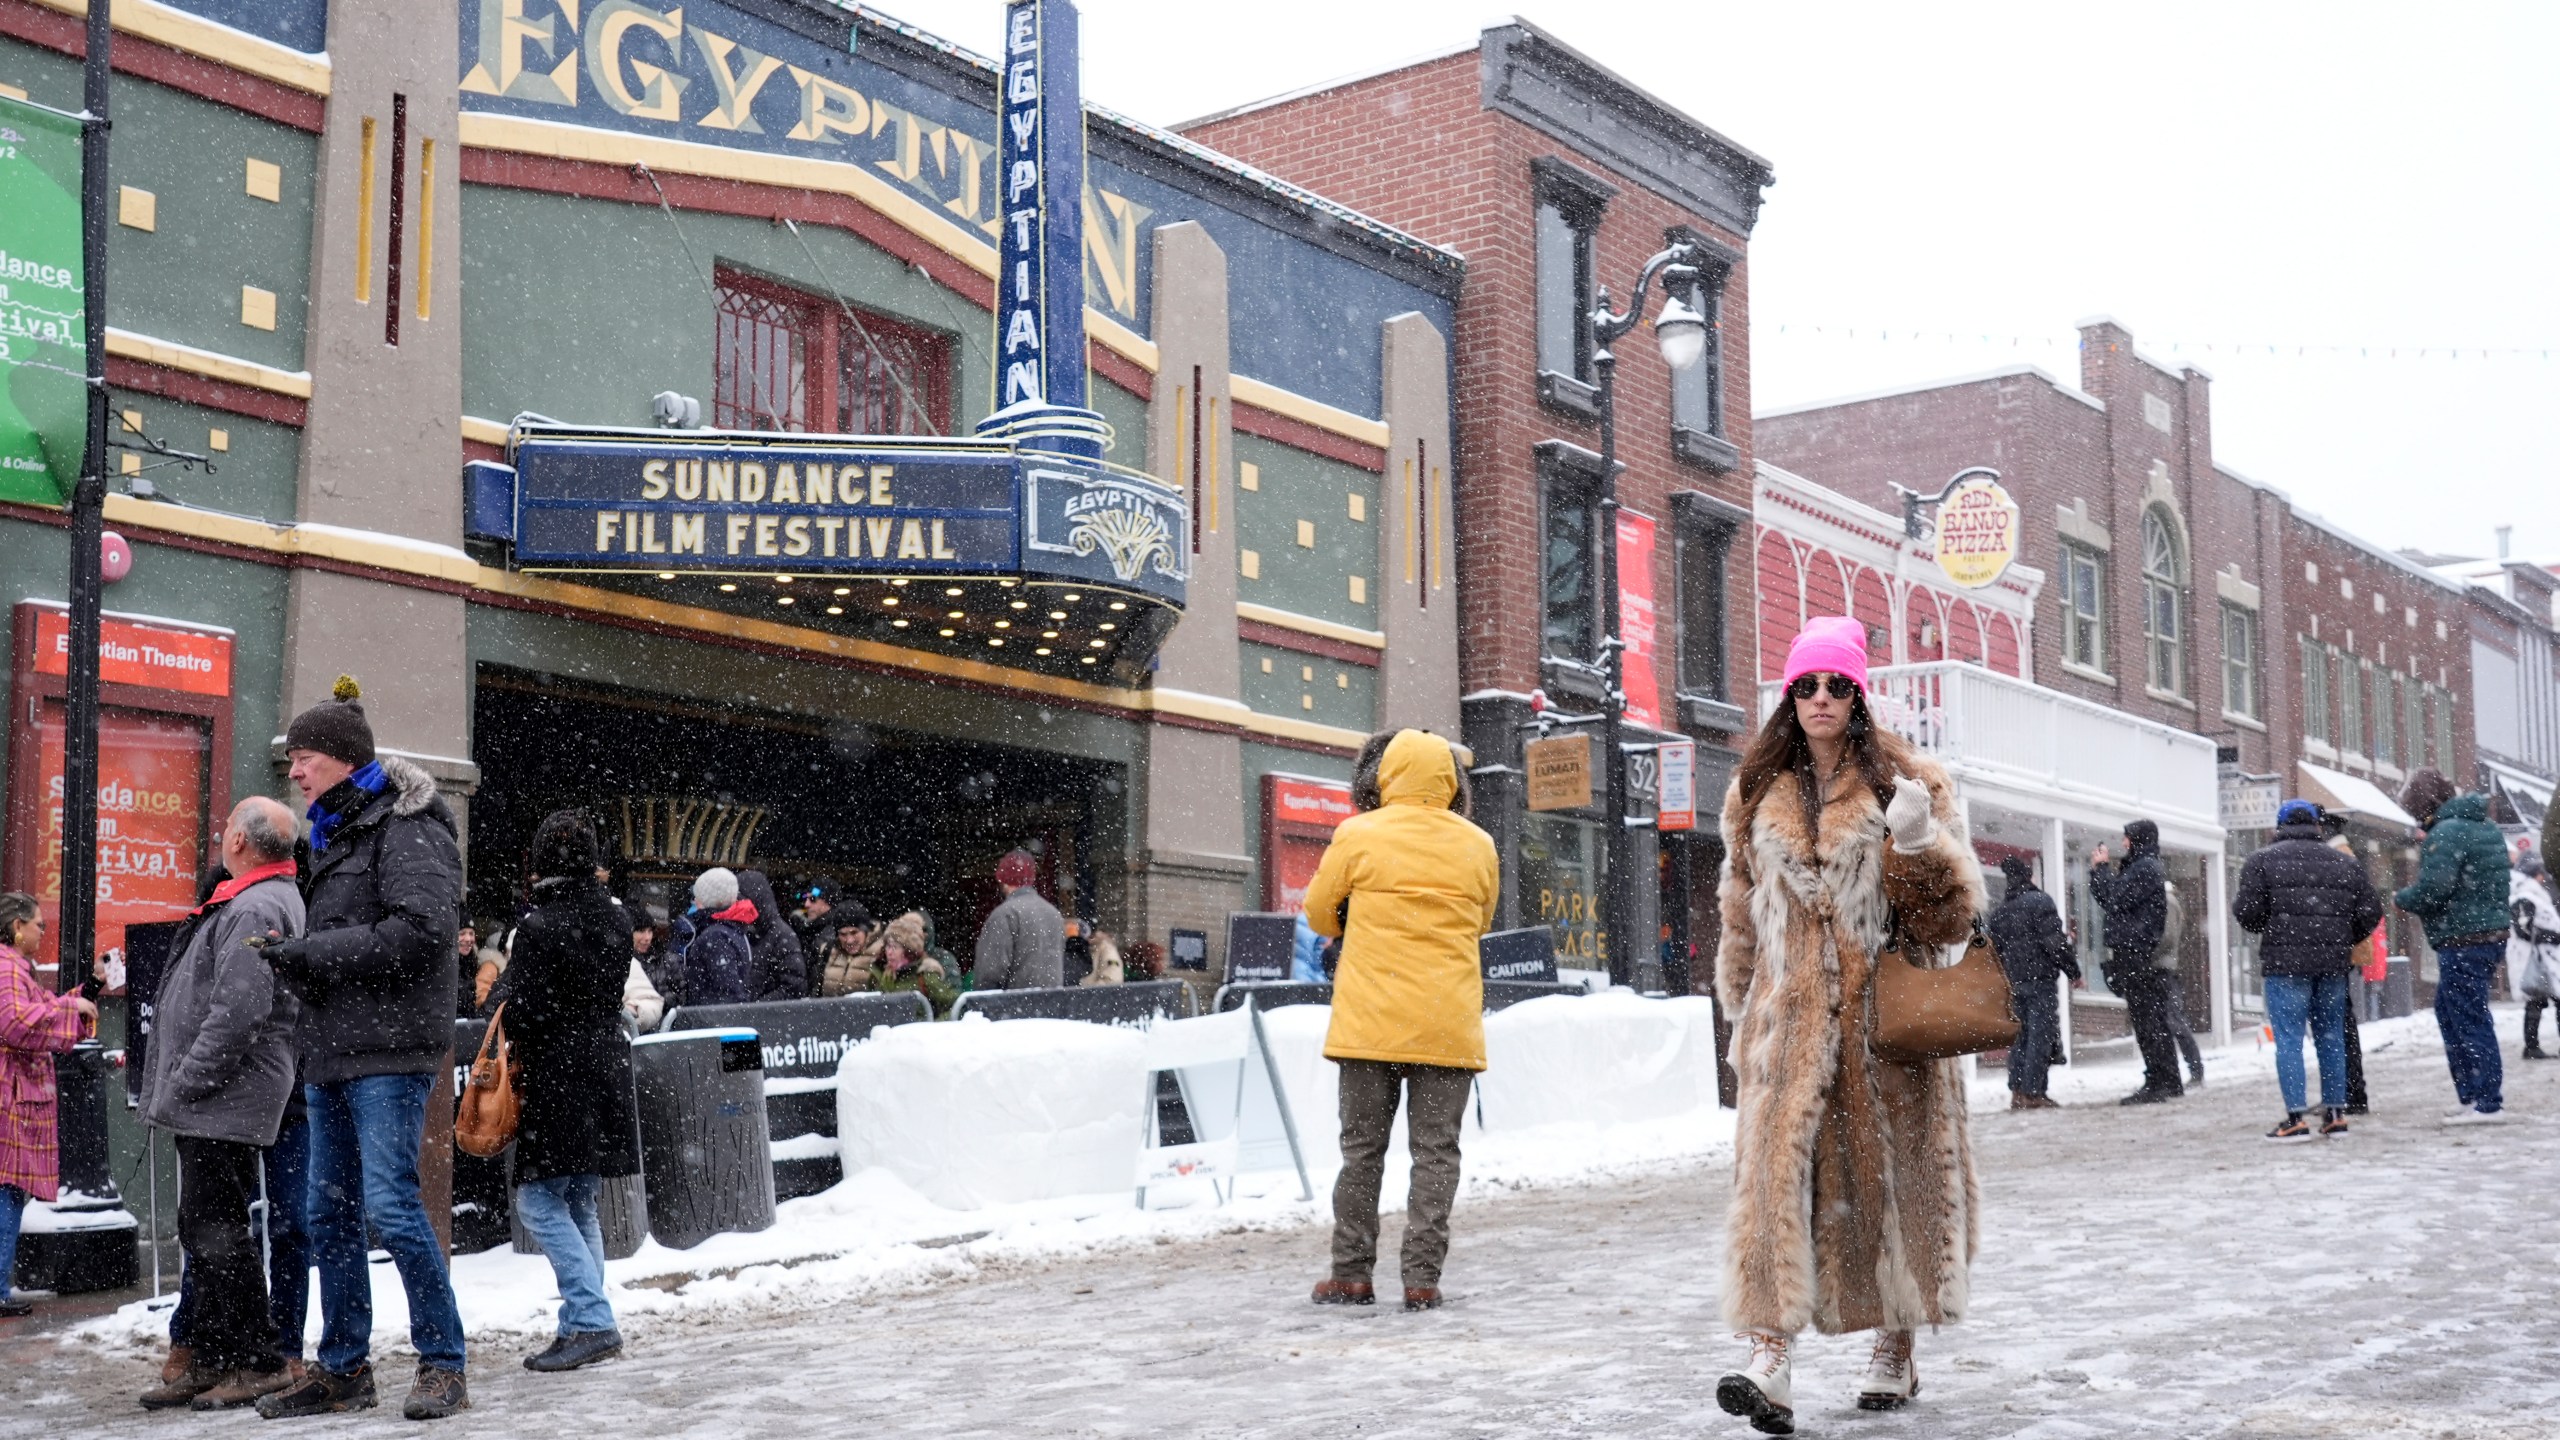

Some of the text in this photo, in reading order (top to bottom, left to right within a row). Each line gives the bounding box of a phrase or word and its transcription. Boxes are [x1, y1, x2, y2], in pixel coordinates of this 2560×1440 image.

[458, 0, 1152, 320] EGYPTIN
[1007, 8, 1041, 405] EGYPTIAN
[641, 458, 895, 506] SUNDANCE
[1064, 489, 1169, 536] EGYPTIAN
[1960, 490, 1993, 509] RED
[596, 511, 956, 561] FILM FESTIVAL
[1944, 511, 2009, 532] BANJO
[1942, 532, 2007, 554] PIZZA
[141, 645, 212, 673] Theatre
[50, 775, 181, 811] Sdance
[1541, 888, 1600, 922] PARK
[1489, 960, 1545, 979] CAUTION
[798, 1036, 839, 1065] film
